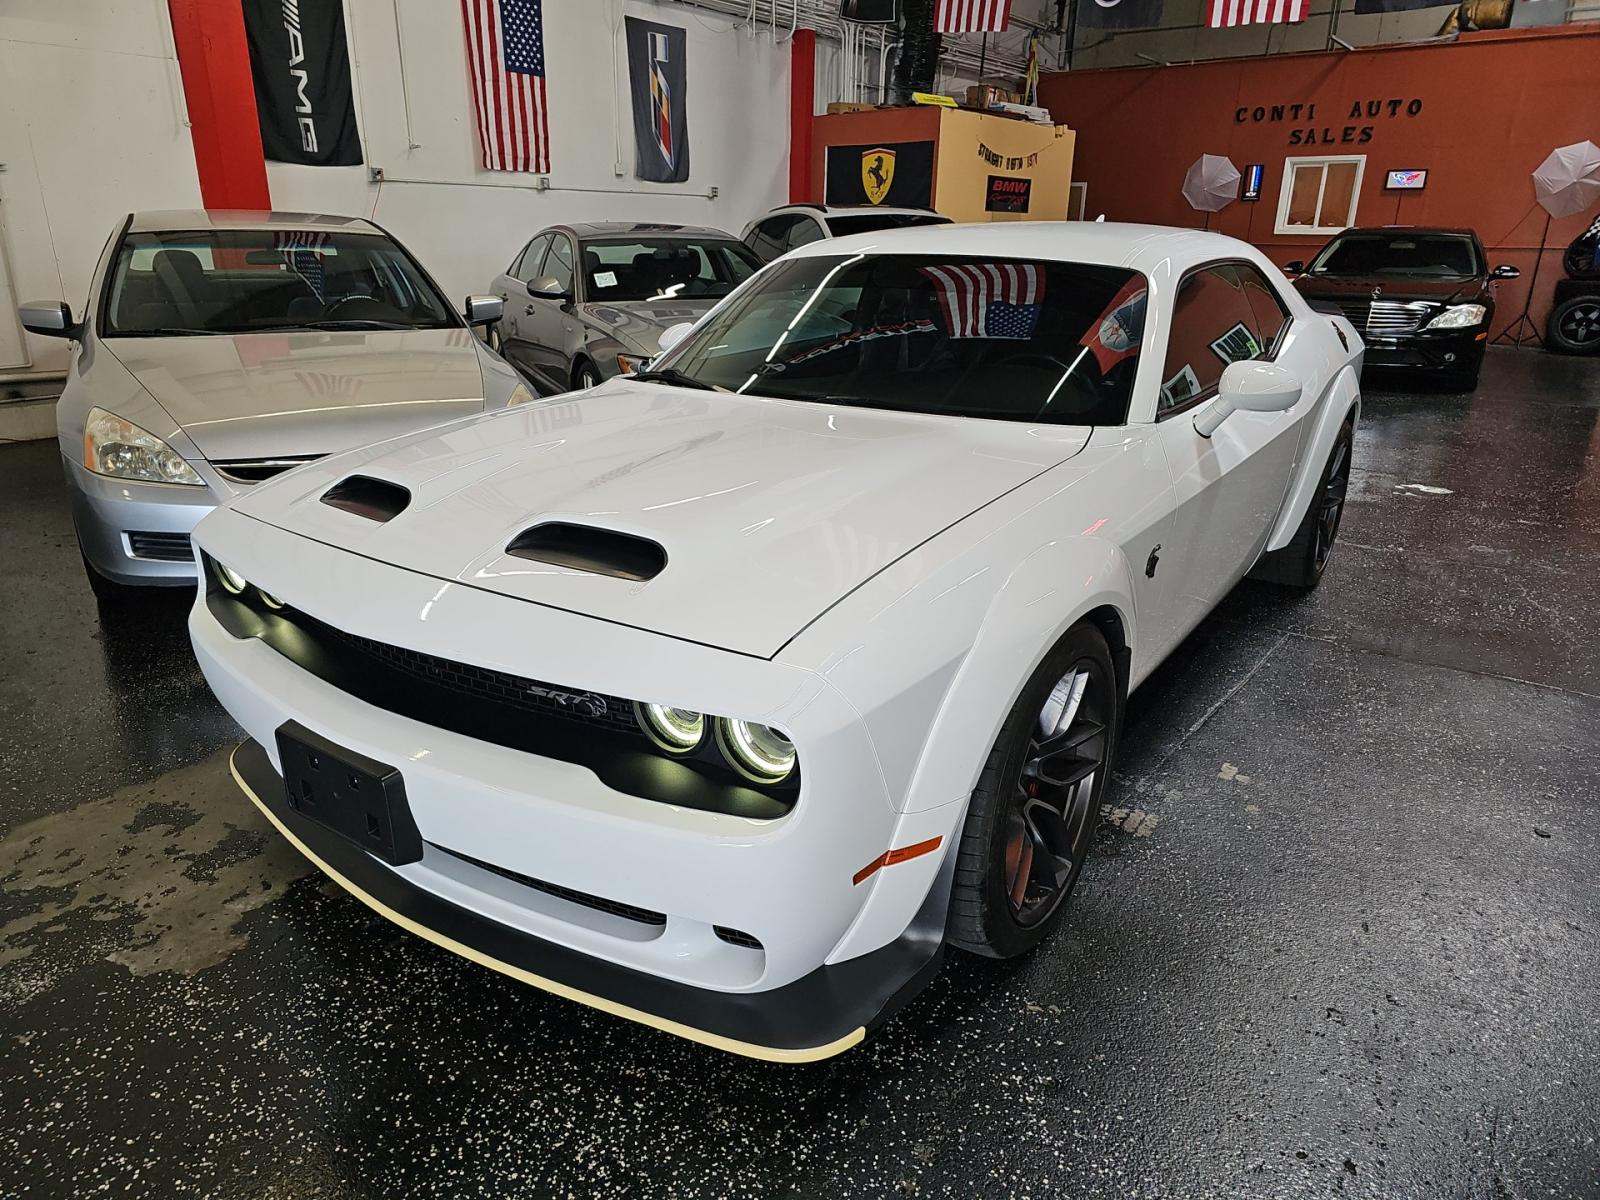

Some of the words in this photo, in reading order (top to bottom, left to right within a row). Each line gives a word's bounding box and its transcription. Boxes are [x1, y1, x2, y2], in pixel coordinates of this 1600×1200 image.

[284, 20, 318, 153] AMG
[1235, 103, 1316, 124] CONTI
[1349, 98, 1423, 119] AUTO
[1289, 126, 1374, 145] SALES
[992, 180, 1028, 193] BMW
[526, 686, 590, 704] SRT
